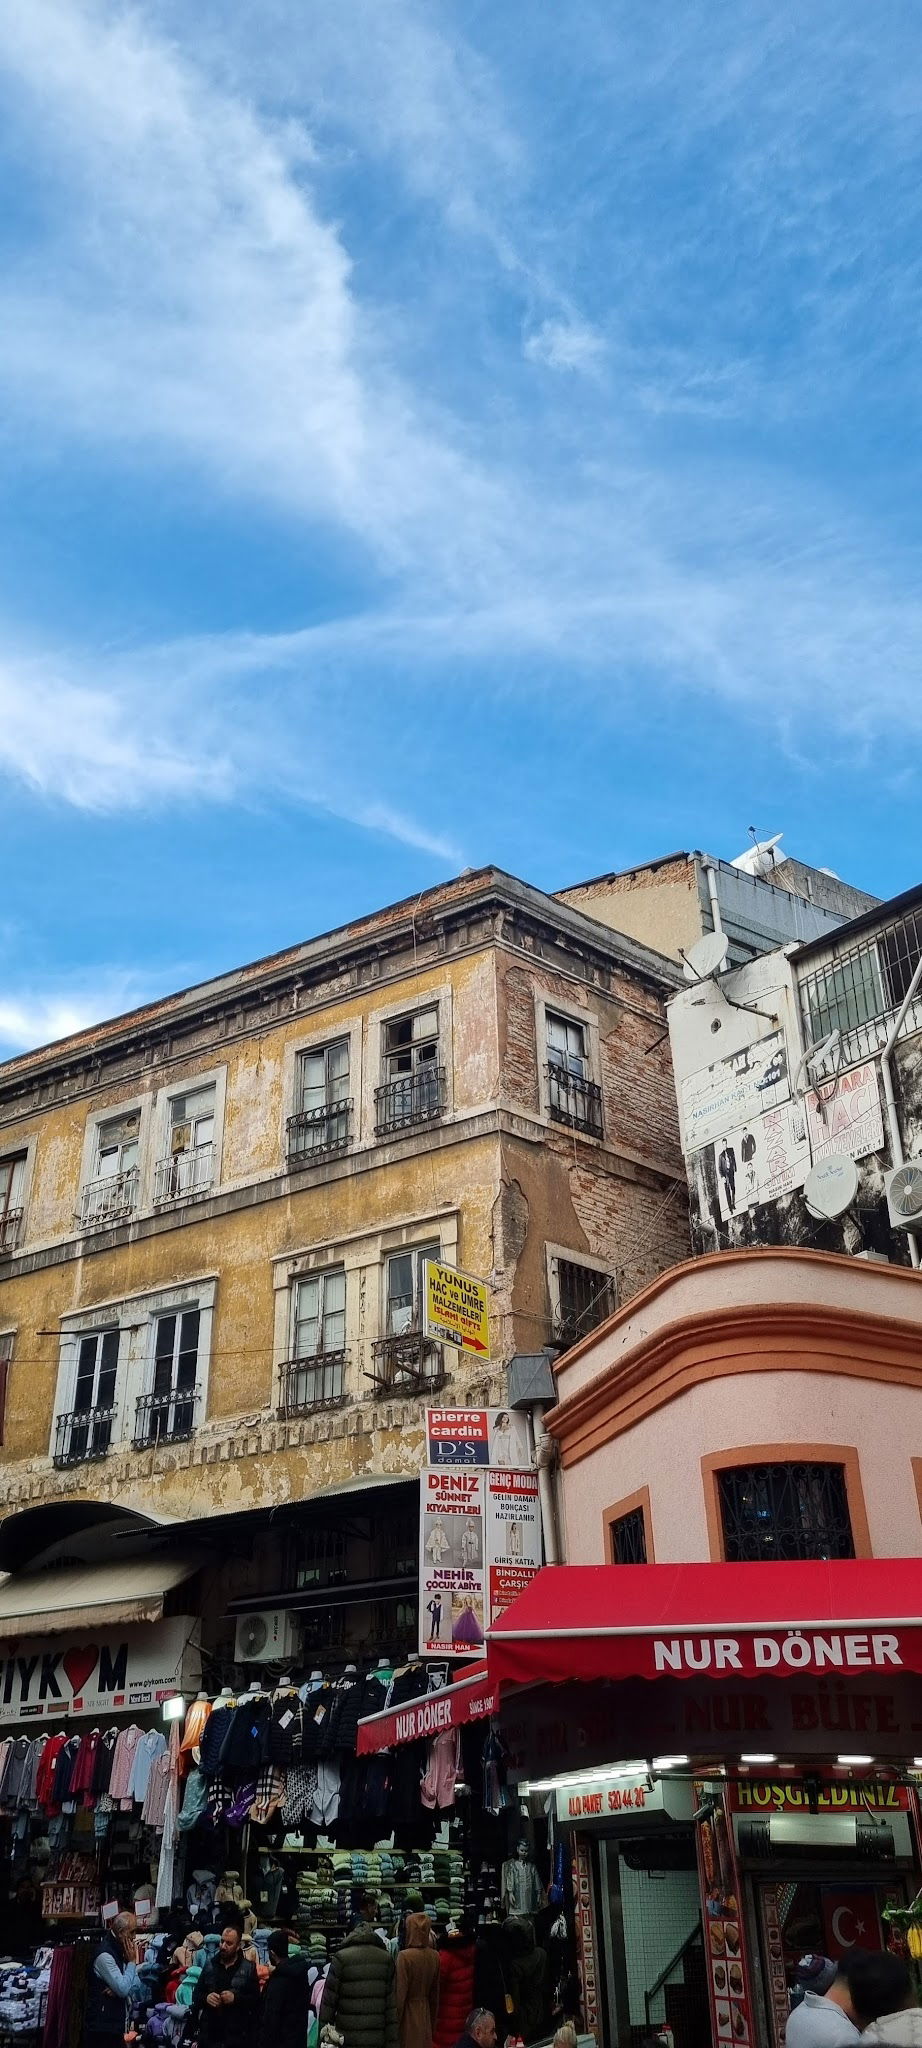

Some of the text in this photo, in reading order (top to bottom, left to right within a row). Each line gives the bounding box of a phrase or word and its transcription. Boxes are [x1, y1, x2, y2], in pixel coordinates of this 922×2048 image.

[809, 1083, 882, 1146] HACI
[437, 1269, 479, 1297] YUNUS
[430, 1277, 484, 1313] HAC ve UMRE
[431, 1411, 481, 1424] pierre
[431, 1425, 483, 1437] cardin
[428, 1472, 479, 1493] DENİZ
[489, 1472, 538, 1490] GENÇ MODA
[435, 1491, 472, 1503] SÜNNET
[493, 1493, 536, 1503] GELİN DAMAT
[426, 1503, 481, 1515] KIYAFETLERİ
[500, 1503, 530, 1513] BOHÇASI
[495, 1512, 535, 1522] HAZIRLANIR
[494, 1556, 535, 1566] GİRİŞ KATTA
[433, 1568, 474, 1581] NEHİR
[495, 1567, 535, 1579] BİNDALLI
[425, 1580, 482, 1591] ÇOCUK ABİYE
[499, 1579, 529, 1590] ÇARŞIS
[430, 1642, 471, 1651] NASIR HAN
[653, 1630, 904, 1670] NUR DÖNER
[685, 1680, 899, 1732] NUR BÜFE
[395, 1711, 416, 1740] NUR
[417, 1698, 452, 1733] DÖNER
